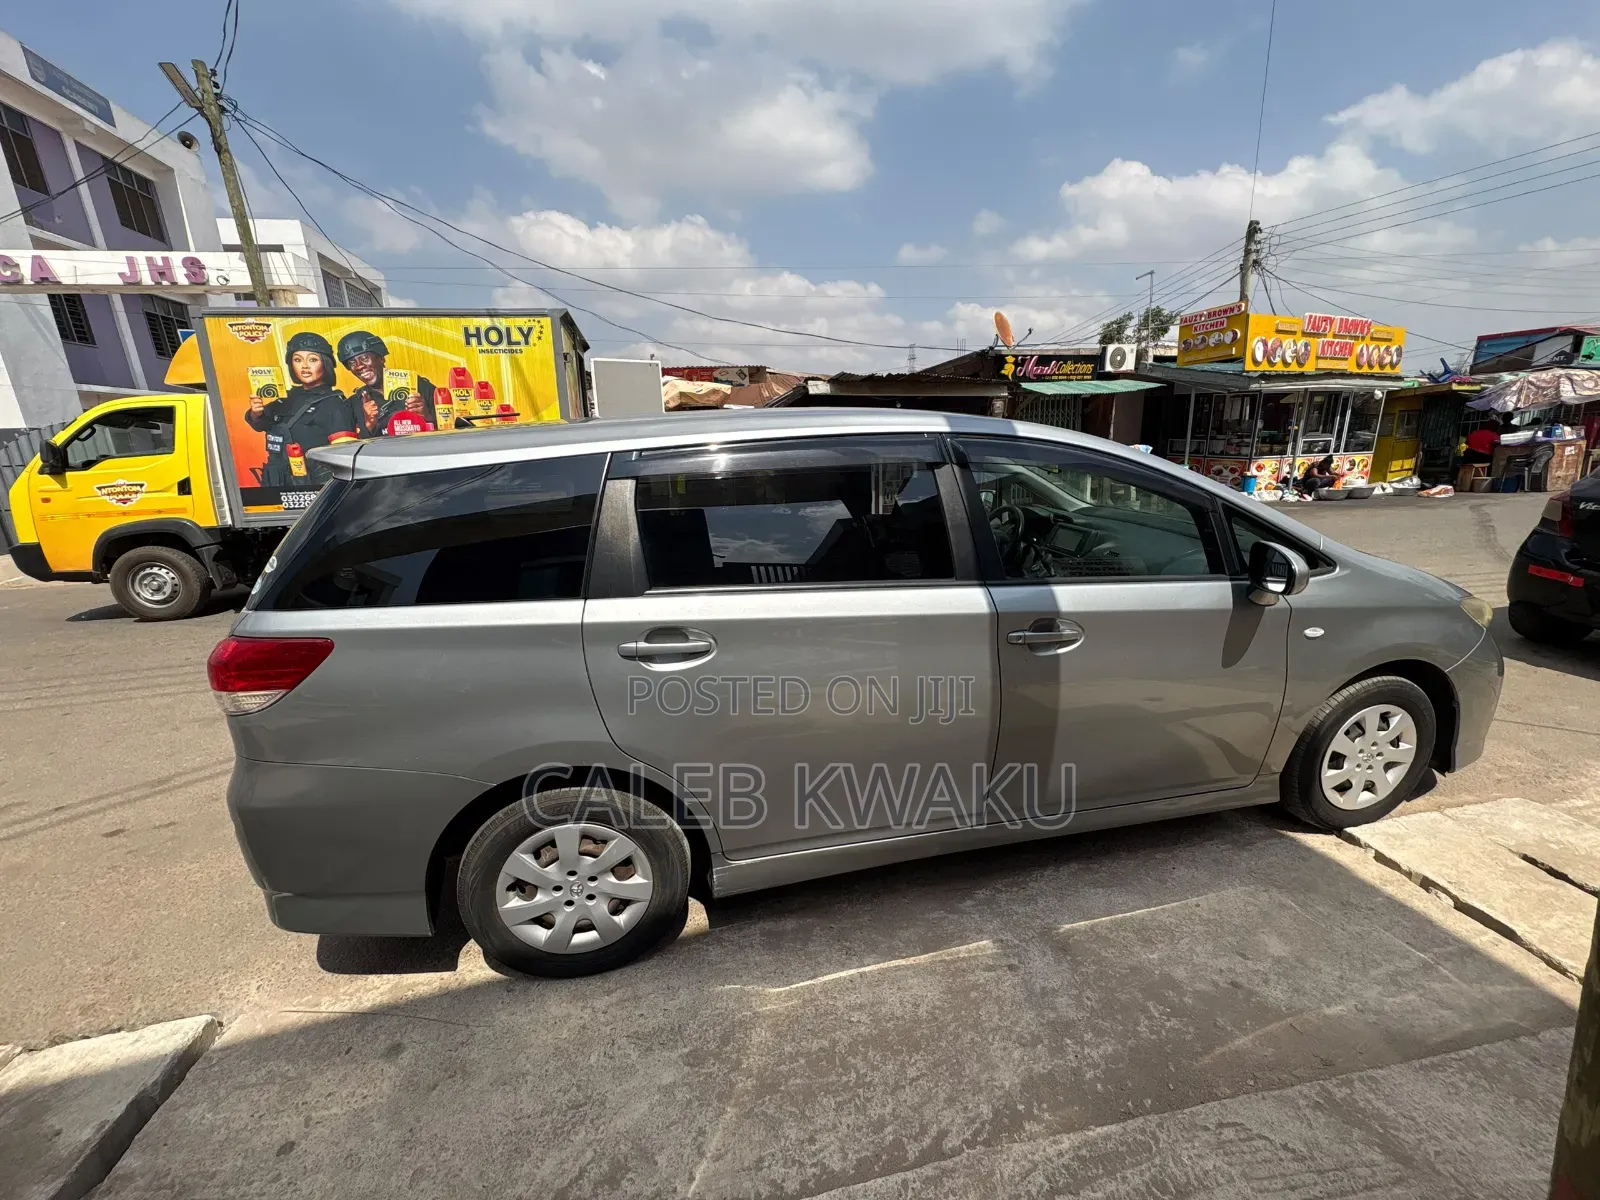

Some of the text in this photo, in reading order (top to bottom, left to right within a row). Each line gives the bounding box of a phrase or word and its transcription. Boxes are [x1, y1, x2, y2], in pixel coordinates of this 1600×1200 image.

[118, 256, 209, 284] JHS
[1180, 304, 1243, 325] FAUZY BROWN'S
[232, 324, 268, 332] NTONTOM
[1193, 319, 1225, 333] KITCHEN
[1306, 315, 1335, 333] FAUZY
[1337, 317, 1372, 336] BROWN'S
[462, 325, 535, 347] HOLY
[1319, 339, 1354, 357] KITCHEN
[394, 424, 421, 432] MOSQUITO
[101, 485, 141, 495] NTONTOM
